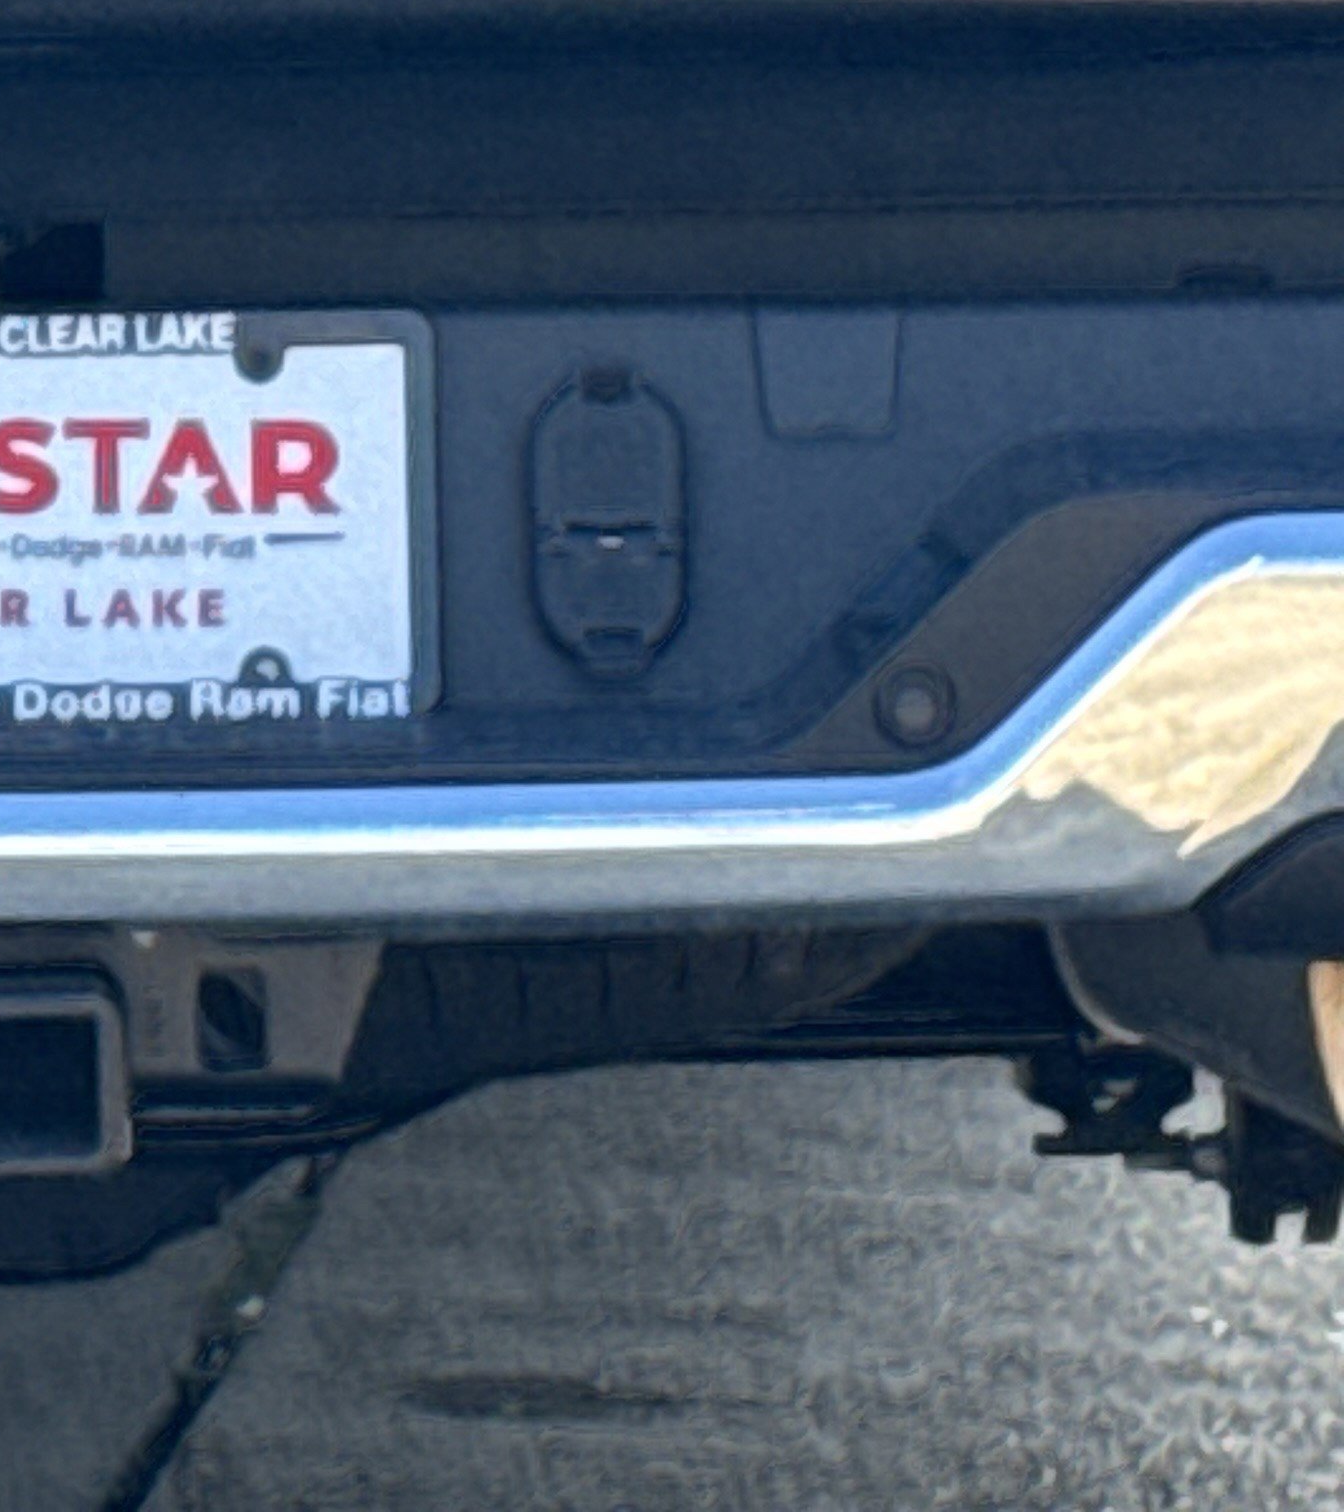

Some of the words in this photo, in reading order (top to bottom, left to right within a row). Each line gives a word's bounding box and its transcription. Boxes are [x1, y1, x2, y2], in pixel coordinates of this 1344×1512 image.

[134, 311, 237, 351] LAKE
[63, 587, 229, 628] LAKE
[189, 678, 304, 723] Ram
[316, 678, 410, 720] Fiat
